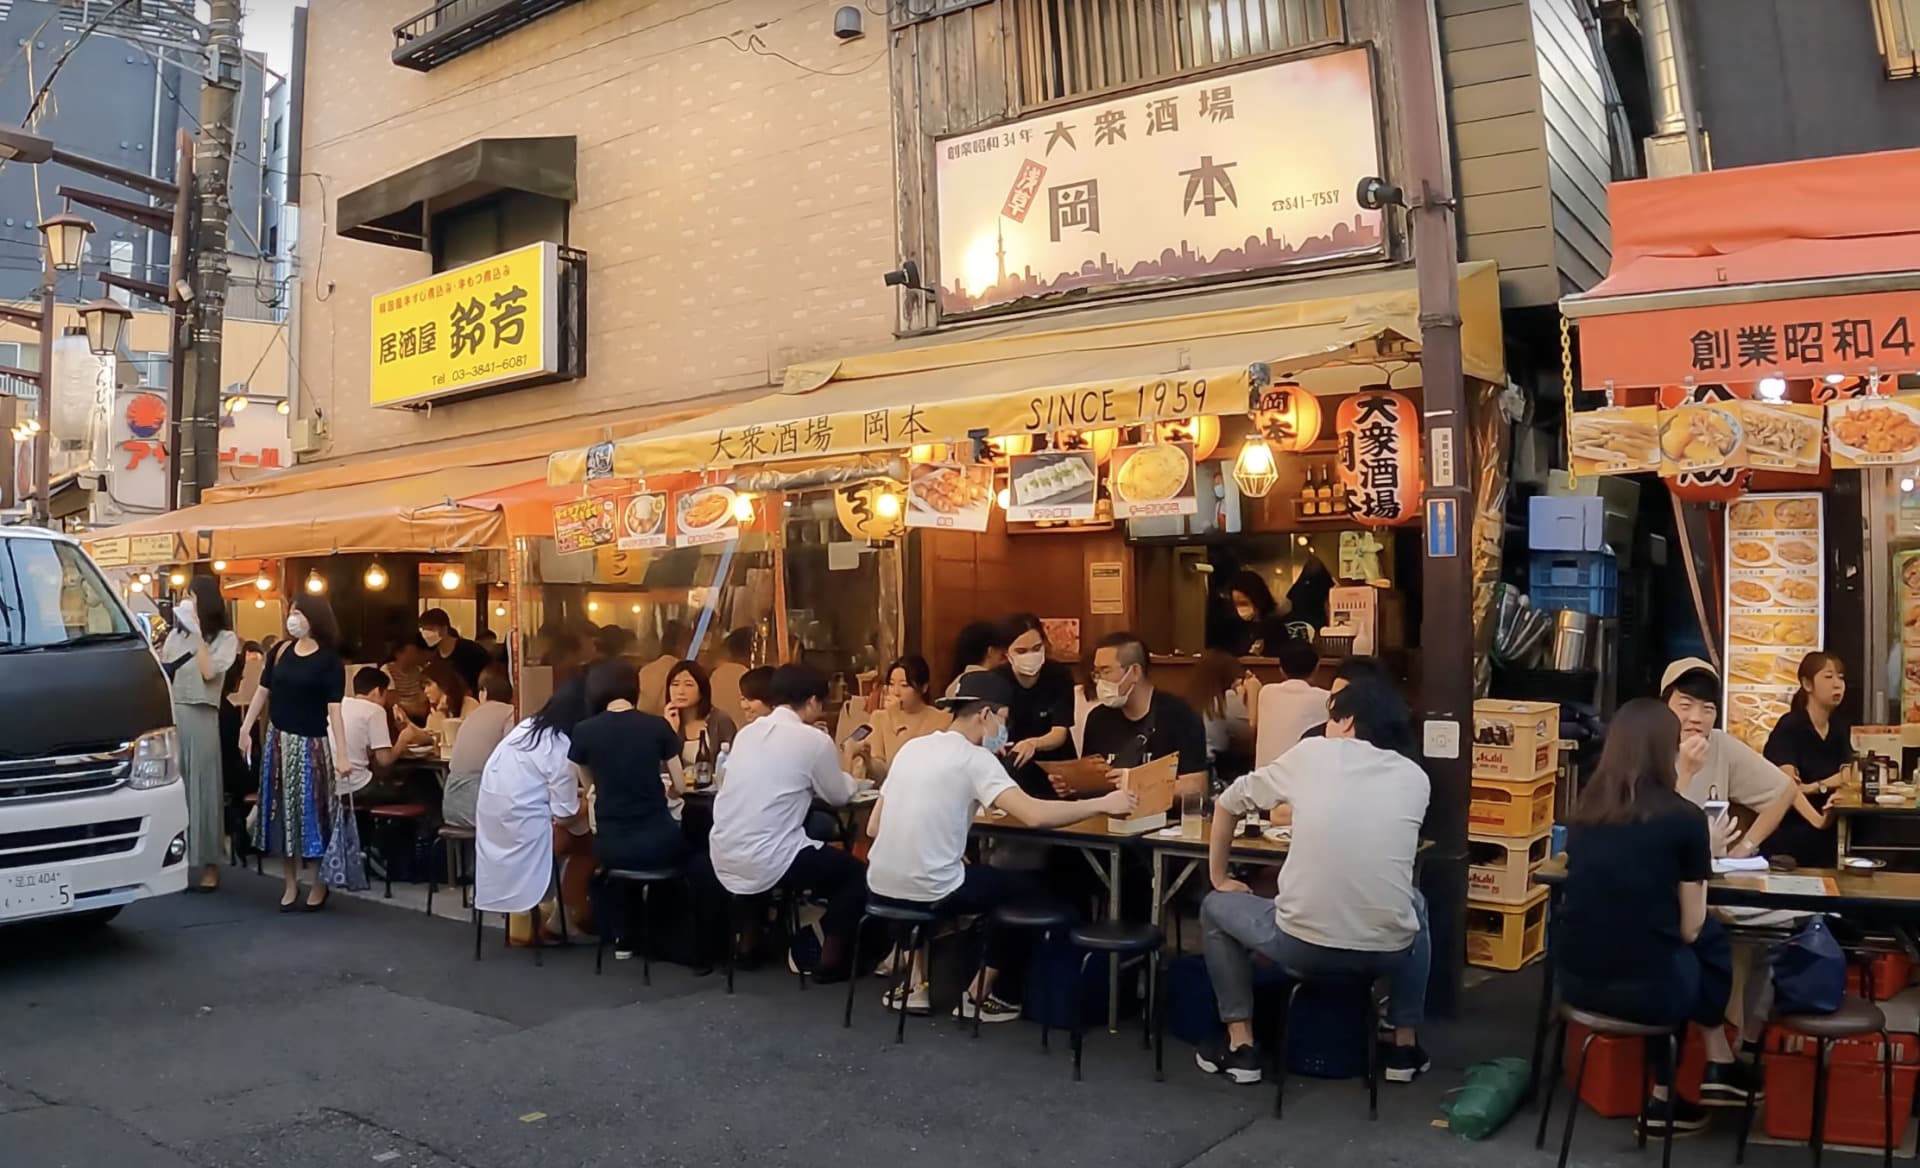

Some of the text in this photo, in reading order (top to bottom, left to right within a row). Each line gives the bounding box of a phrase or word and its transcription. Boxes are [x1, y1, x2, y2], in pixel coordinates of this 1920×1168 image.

[1044, 86, 1234, 157] 大衆酒場
[1007, 164, 1043, 217] 浅草
[1048, 156, 1238, 242] 岡本
[379, 284, 528, 365] 居酒屋 鈴芳
[1690, 315, 1916, 370] 創業昭和4
[432, 354, 528, 386] Tel 03-3841-6081
[710, 379, 1207, 462] 大衆酒場 岡本 SINCE 1959
[1260, 391, 1298, 444] 岡本
[1354, 396, 1399, 519] 大衆酒場
